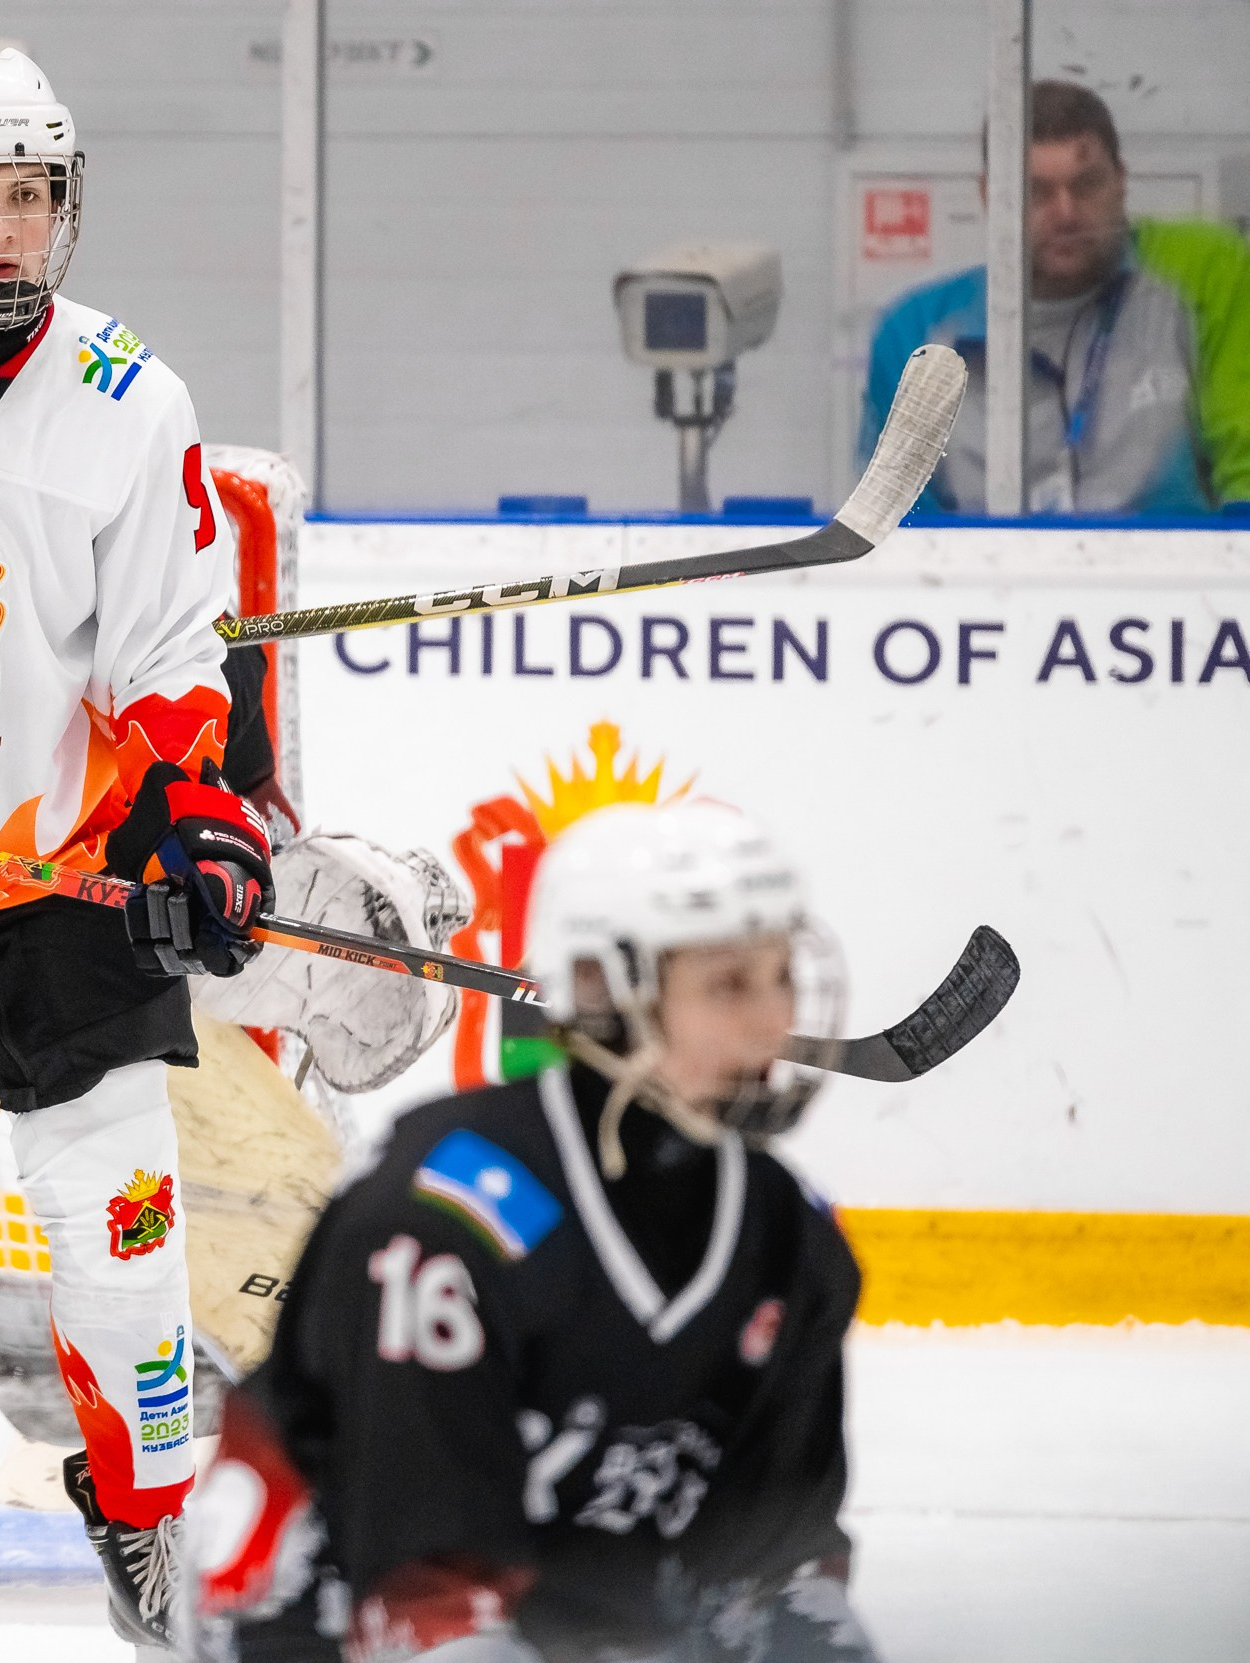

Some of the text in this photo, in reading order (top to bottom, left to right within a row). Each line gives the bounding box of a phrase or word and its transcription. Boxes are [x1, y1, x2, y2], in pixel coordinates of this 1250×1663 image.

[413, 564, 621, 616] CCM
[245, 620, 285, 635] PRO
[334, 610, 1250, 685] CHILDREN OF ASIA
[317, 943, 344, 961] MID
[345, 948, 376, 966] KICK
[367, 1233, 487, 1373] 16
[139, 1410, 169, 1422] Дети
